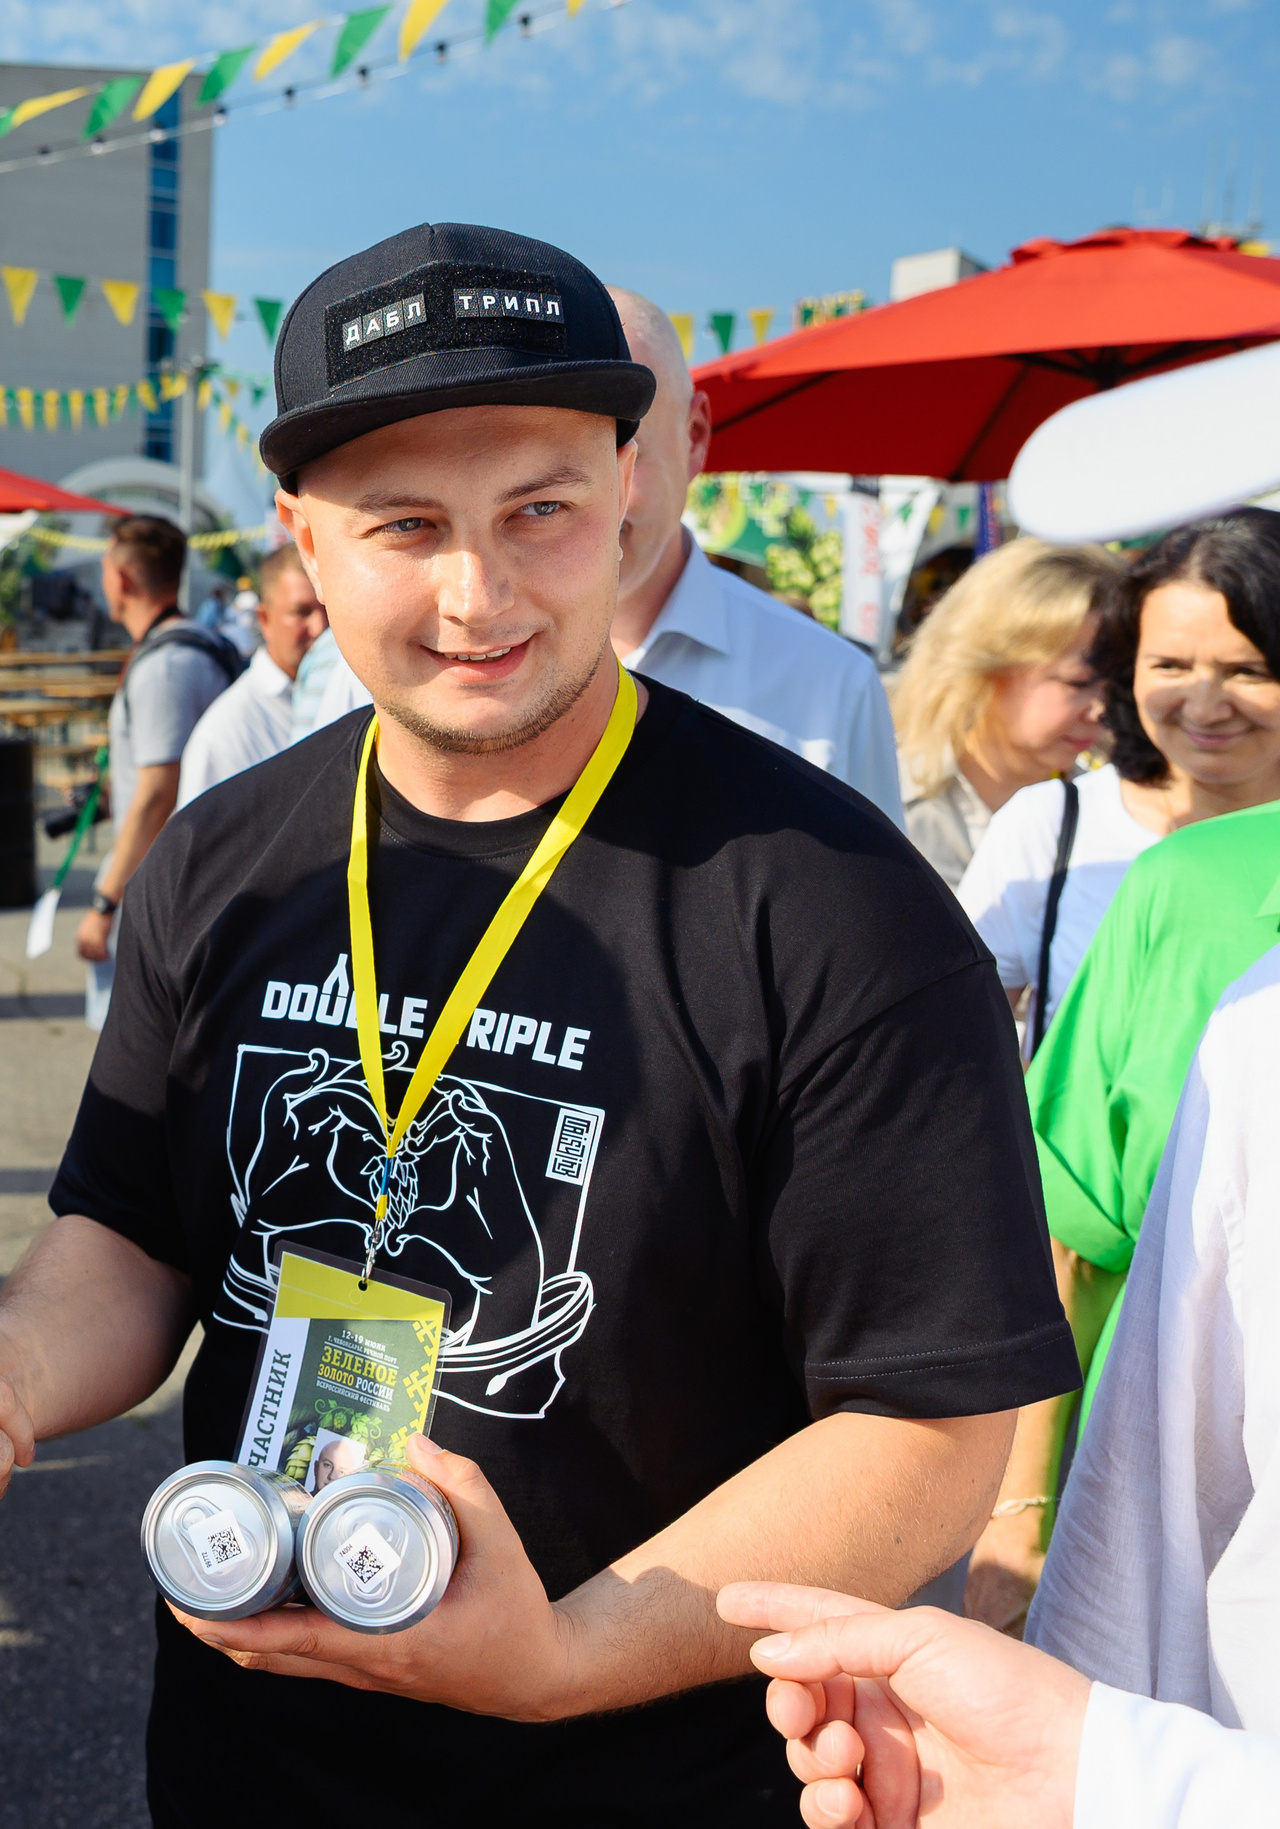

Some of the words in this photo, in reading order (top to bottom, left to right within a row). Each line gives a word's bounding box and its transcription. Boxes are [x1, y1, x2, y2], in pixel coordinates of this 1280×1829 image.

[345, 301, 422, 345] ДАБЛ
[458, 295, 561, 316] ТРИПЛ
[456, 1007, 591, 1071] RIPLE
[341, 1330, 364, 1344] 12-19
[317, 1364, 355, 1387] ЗОЛОТО
[355, 1376, 395, 1401] РОССИИ
[321, 1345, 398, 1387] ЗЕЛЕНОЕ
[248, 1349, 292, 1466] ЧАСТНИК
[359, 1396, 391, 1412] ФЕСТИВАЛЬ
